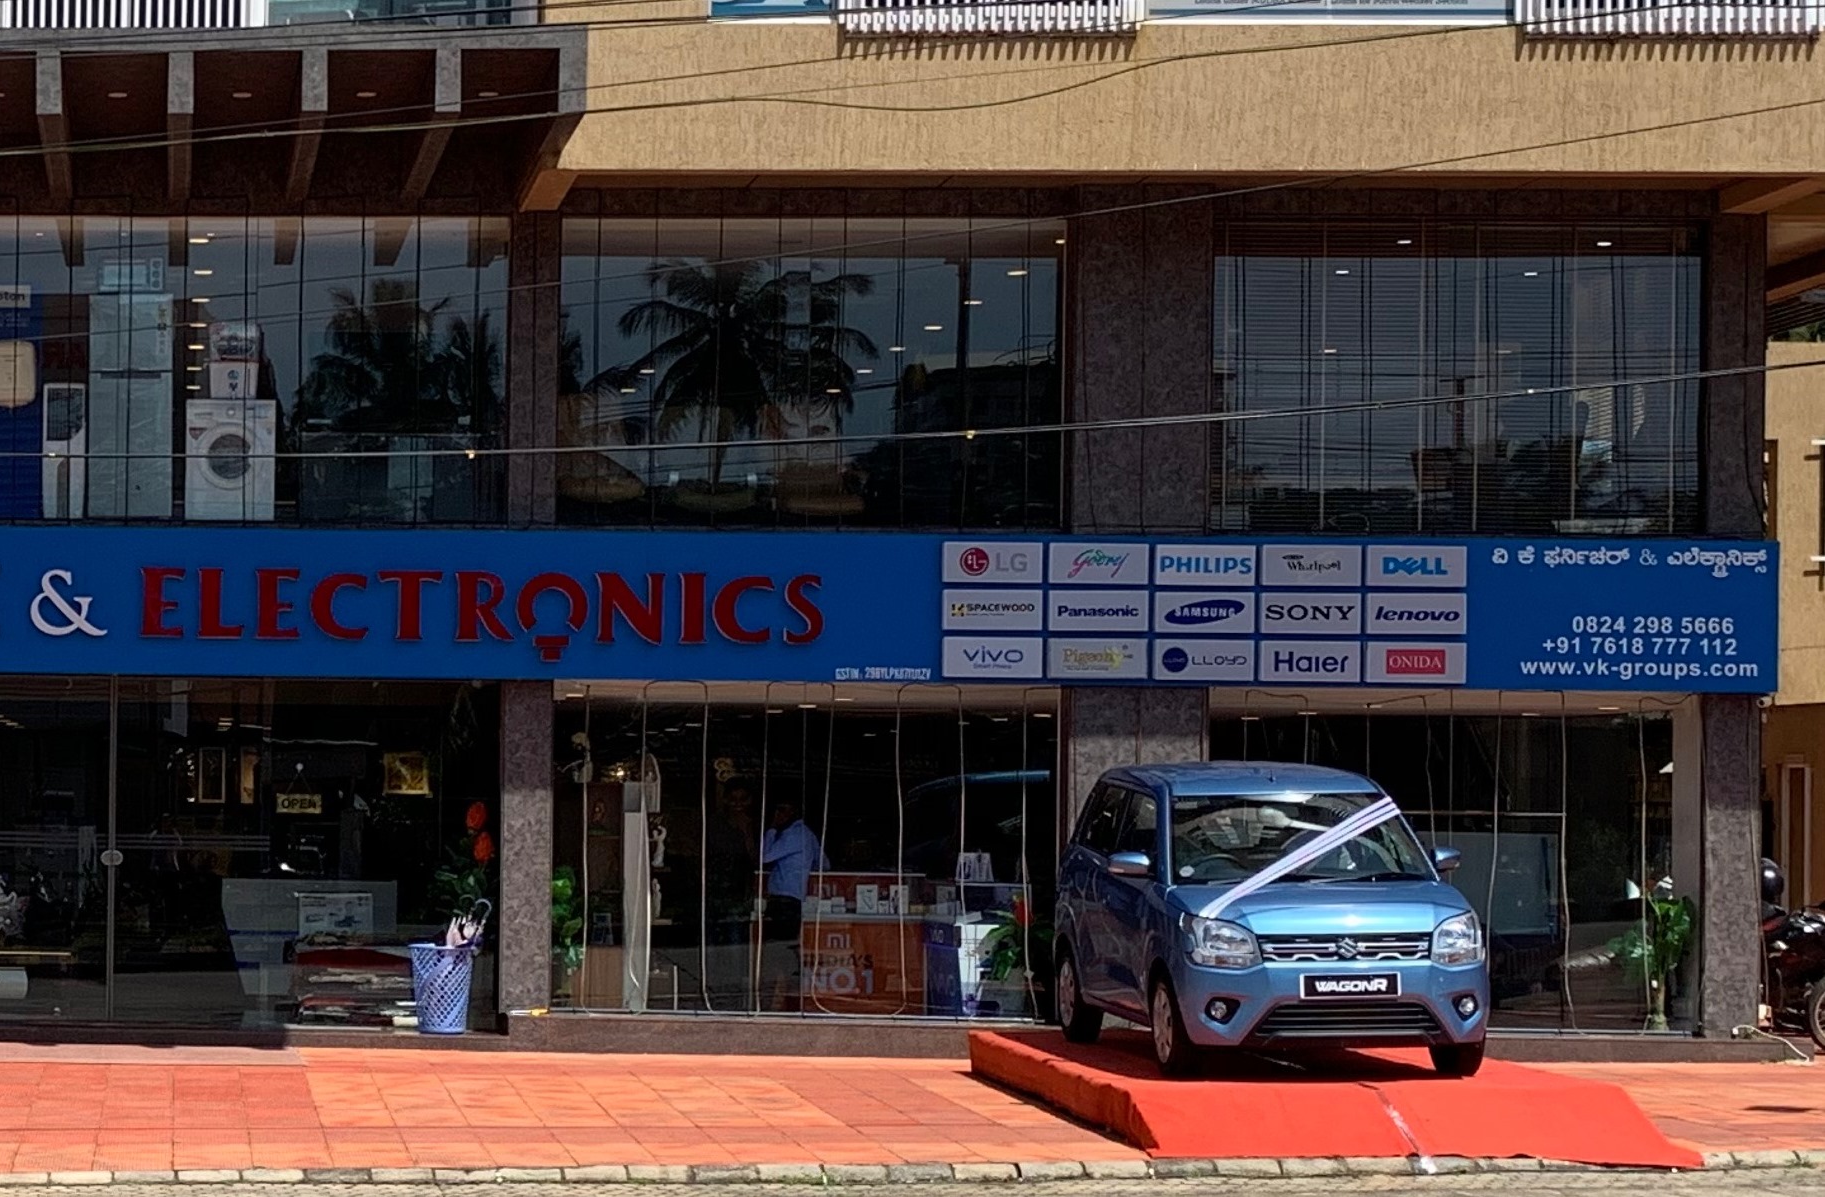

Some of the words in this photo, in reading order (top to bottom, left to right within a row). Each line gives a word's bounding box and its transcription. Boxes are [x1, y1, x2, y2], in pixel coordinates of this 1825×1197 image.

[995, 553, 1028, 573] LG
[1067, 548, 1130, 579] Godrej
[1159, 556, 1253, 575] PHILIPS
[1639, 548, 1658, 566] &
[1382, 557, 1449, 576] DELL
[29, 568, 109, 636] &
[138, 566, 825, 660] ELECTRONICS
[966, 603, 1036, 613] SPACEWOOD
[1057, 604, 1140, 618] Panasonic
[1173, 606, 1236, 618] SAMSUNG
[1265, 604, 1355, 621] SONY
[1374, 605, 1461, 622] lenovo
[1572, 615, 1626, 635] 0824
[1633, 616, 1673, 635] 298
[1680, 617, 1735, 636] 5666
[963, 645, 1024, 664] vivo
[1542, 636, 1581, 655] +91
[1590, 636, 1644, 656] 7618
[1651, 637, 1690, 656] 777
[1699, 637, 1738, 656] 112
[1191, 655, 1248, 666] LLOYD
[1274, 650, 1349, 674] Haier
[1388, 655, 1443, 669] ONIDA
[1520, 657, 1759, 681] www.vk-groups.com
[281, 798, 317, 809] OPEN
[1314, 978, 1388, 993] WAGONR
